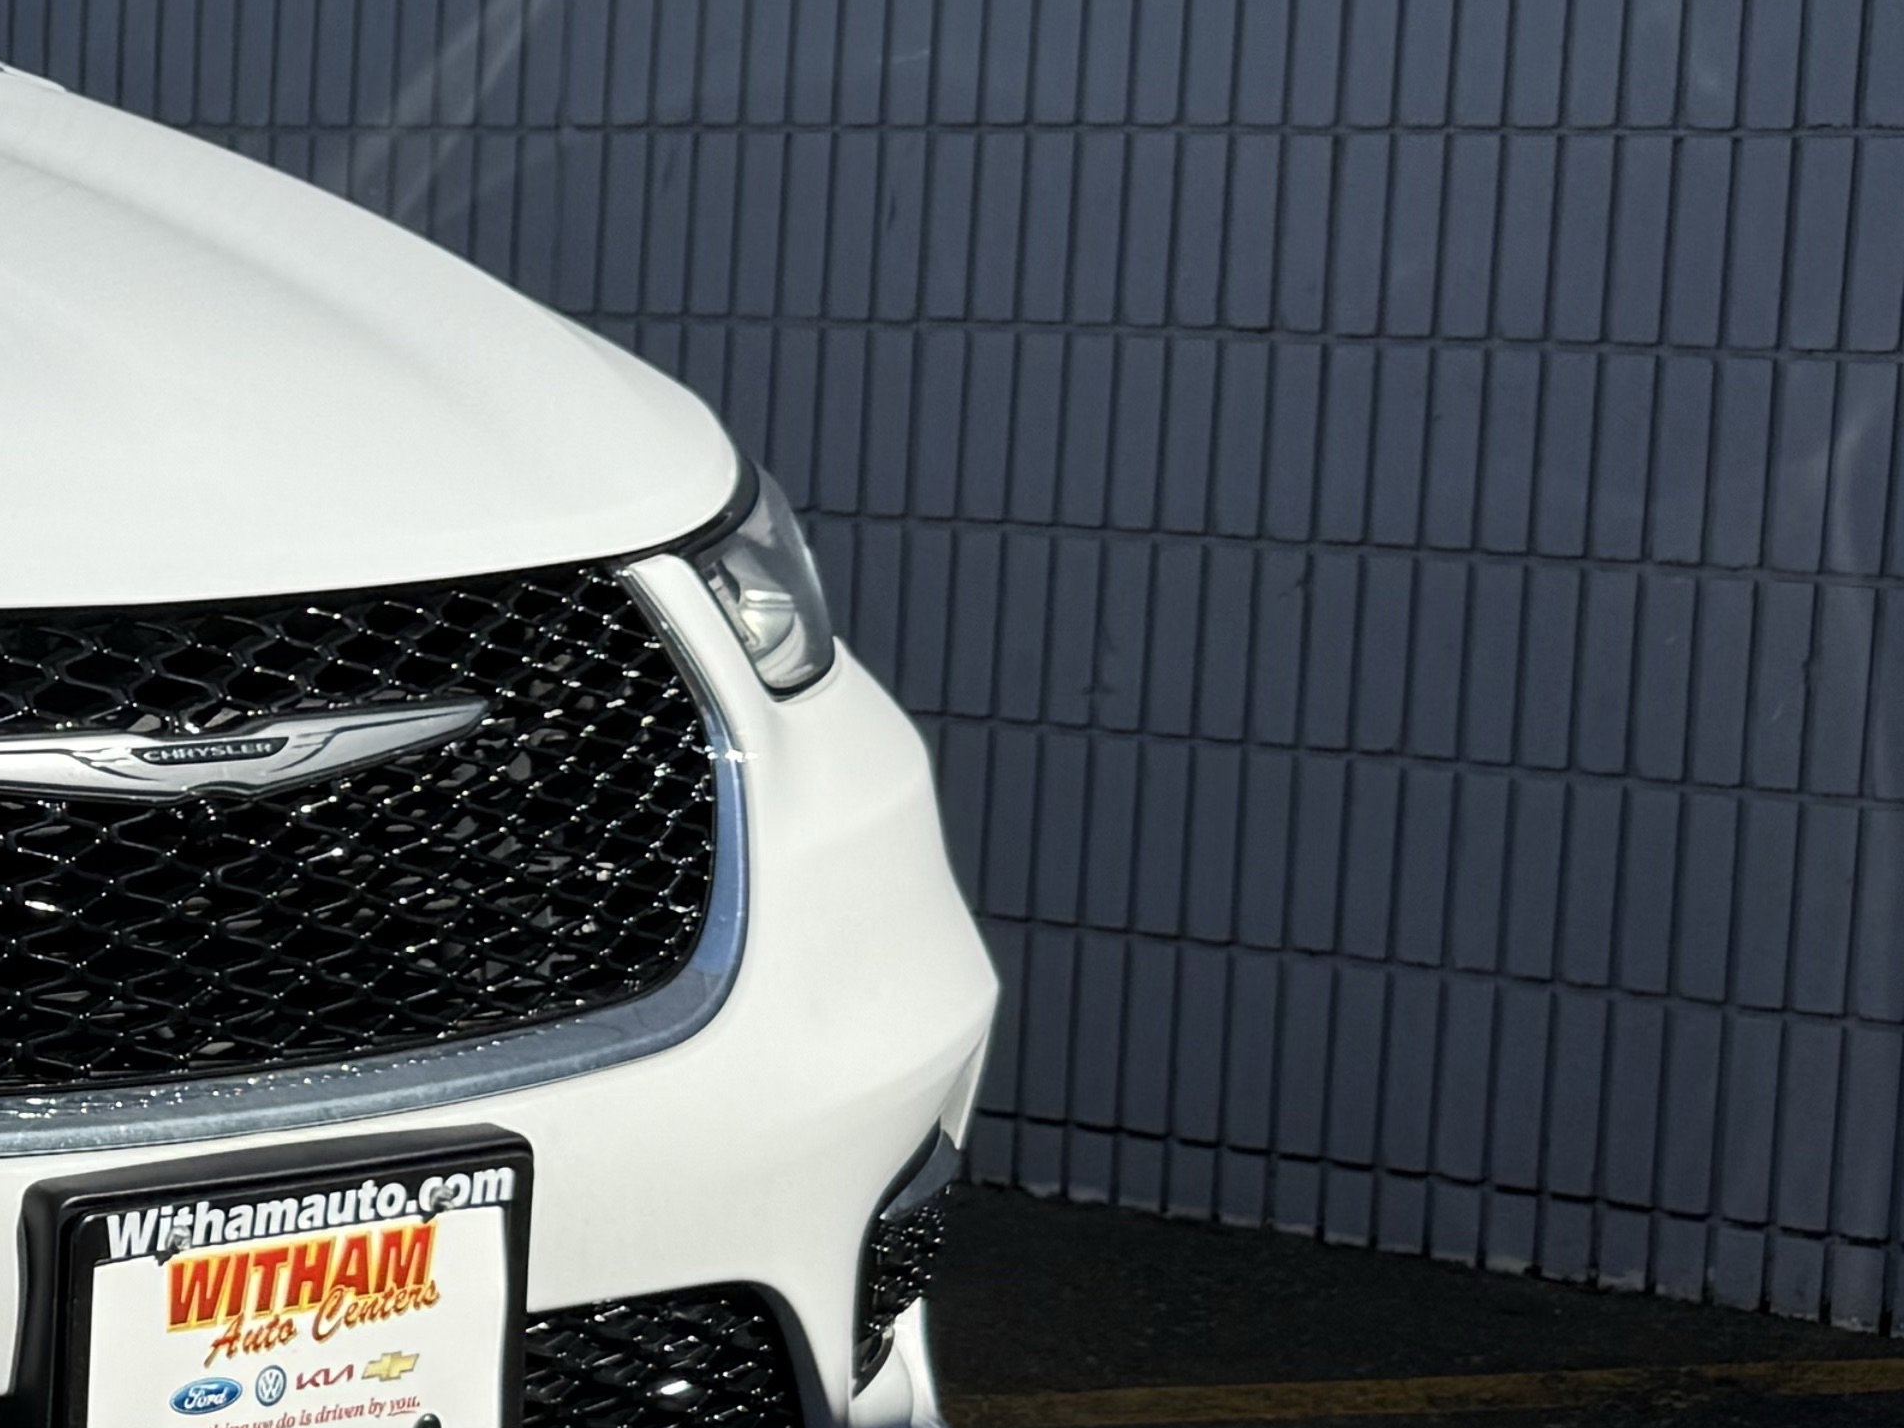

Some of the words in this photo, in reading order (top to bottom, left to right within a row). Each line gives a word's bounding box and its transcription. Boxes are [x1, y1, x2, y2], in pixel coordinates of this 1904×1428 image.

[142, 742, 272, 762] CHRYSLER
[106, 1166, 515, 1259] Withamauto.com
[168, 1221, 436, 1330] WITHAM
[204, 1312, 297, 1368] Auto
[312, 1279, 441, 1344] Centers
[299, 1409, 313, 1426] is
[314, 1401, 364, 1424] driven
[368, 1397, 386, 1419] by
[389, 1395, 422, 1417] you.
